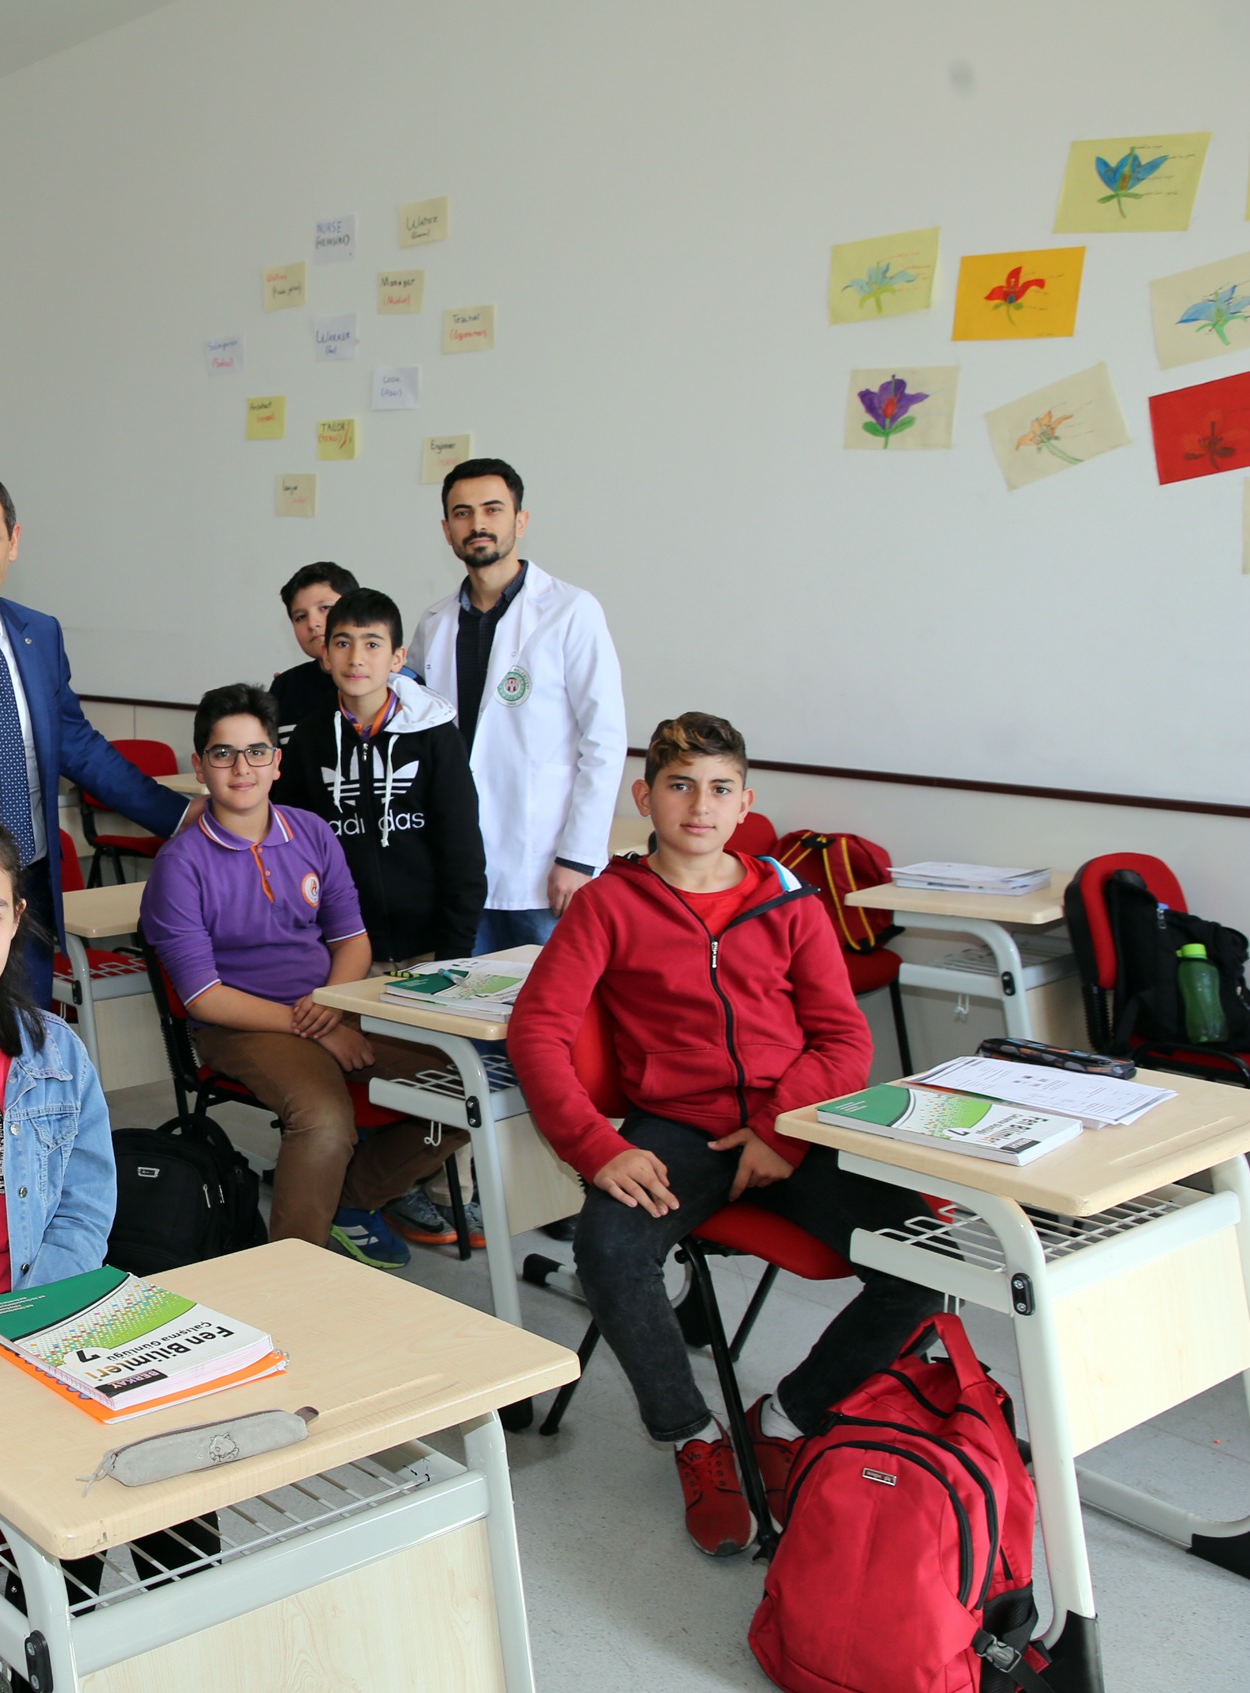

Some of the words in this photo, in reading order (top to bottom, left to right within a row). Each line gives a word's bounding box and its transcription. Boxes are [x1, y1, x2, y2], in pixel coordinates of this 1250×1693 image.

[317, 220, 342, 233] NURSE
[381, 276, 415, 288] Manager
[321, 422, 345, 432] TAILOR
[161, 1321, 212, 1343] Çalışma
[185, 1325, 235, 1346] Fen
[76, 1349, 100, 1363] 7
[106, 1340, 162, 1362] Günlüğü
[84, 1342, 192, 1382] Bilimleri
[110, 1369, 160, 1390] BERKAY
